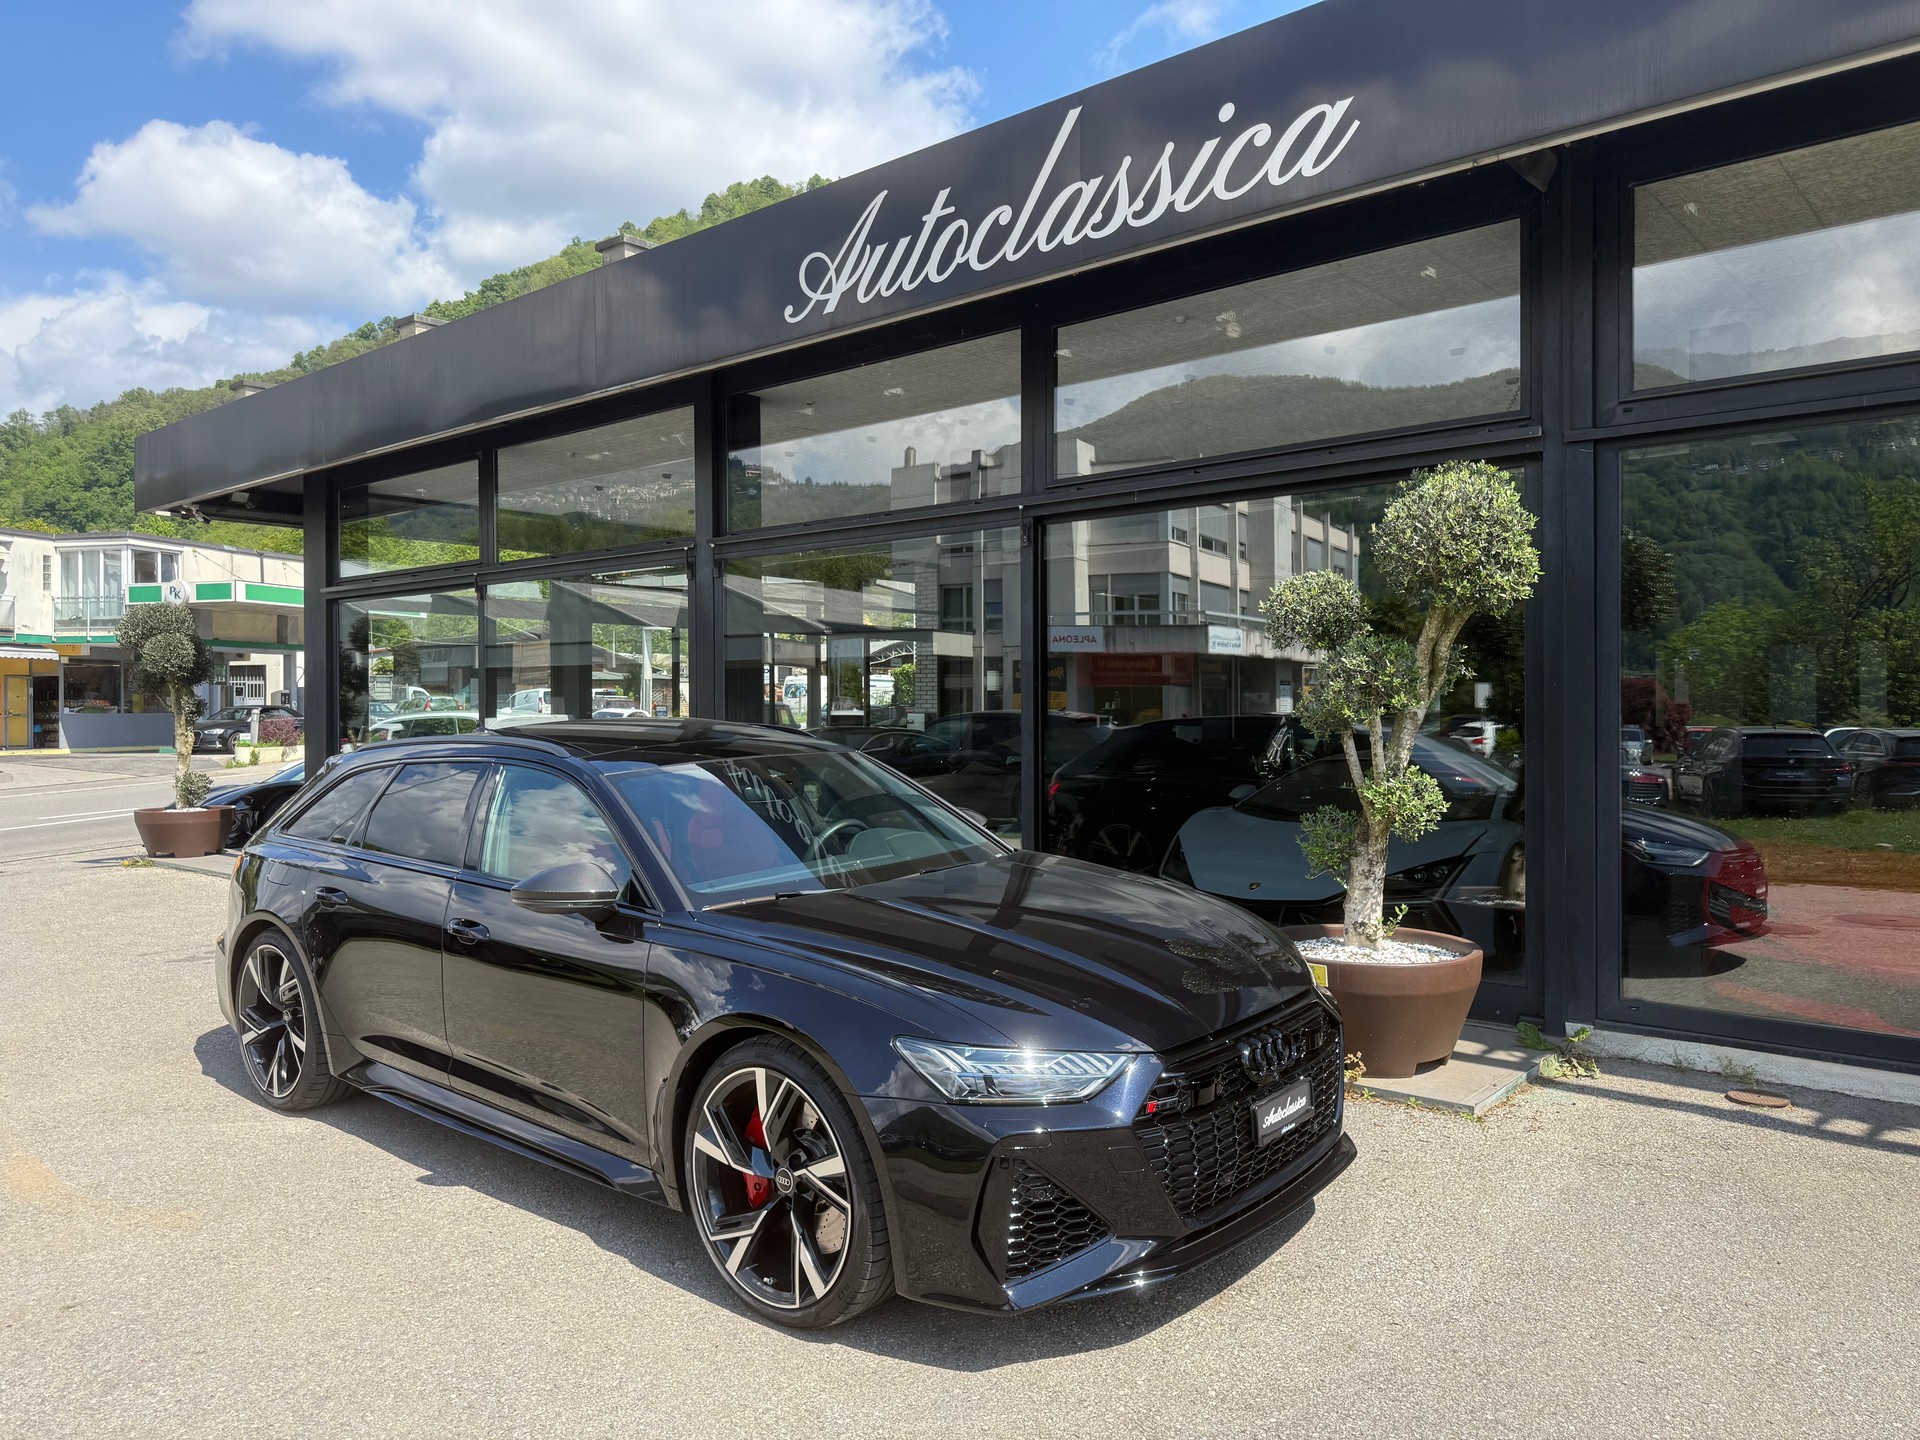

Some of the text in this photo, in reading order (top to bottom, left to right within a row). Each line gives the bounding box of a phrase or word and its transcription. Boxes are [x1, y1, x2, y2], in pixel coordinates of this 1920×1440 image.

[784, 96, 1360, 323] Autoclassica
[169, 586, 181, 600] PK
[1262, 1096, 1307, 1129] Autoclassica
